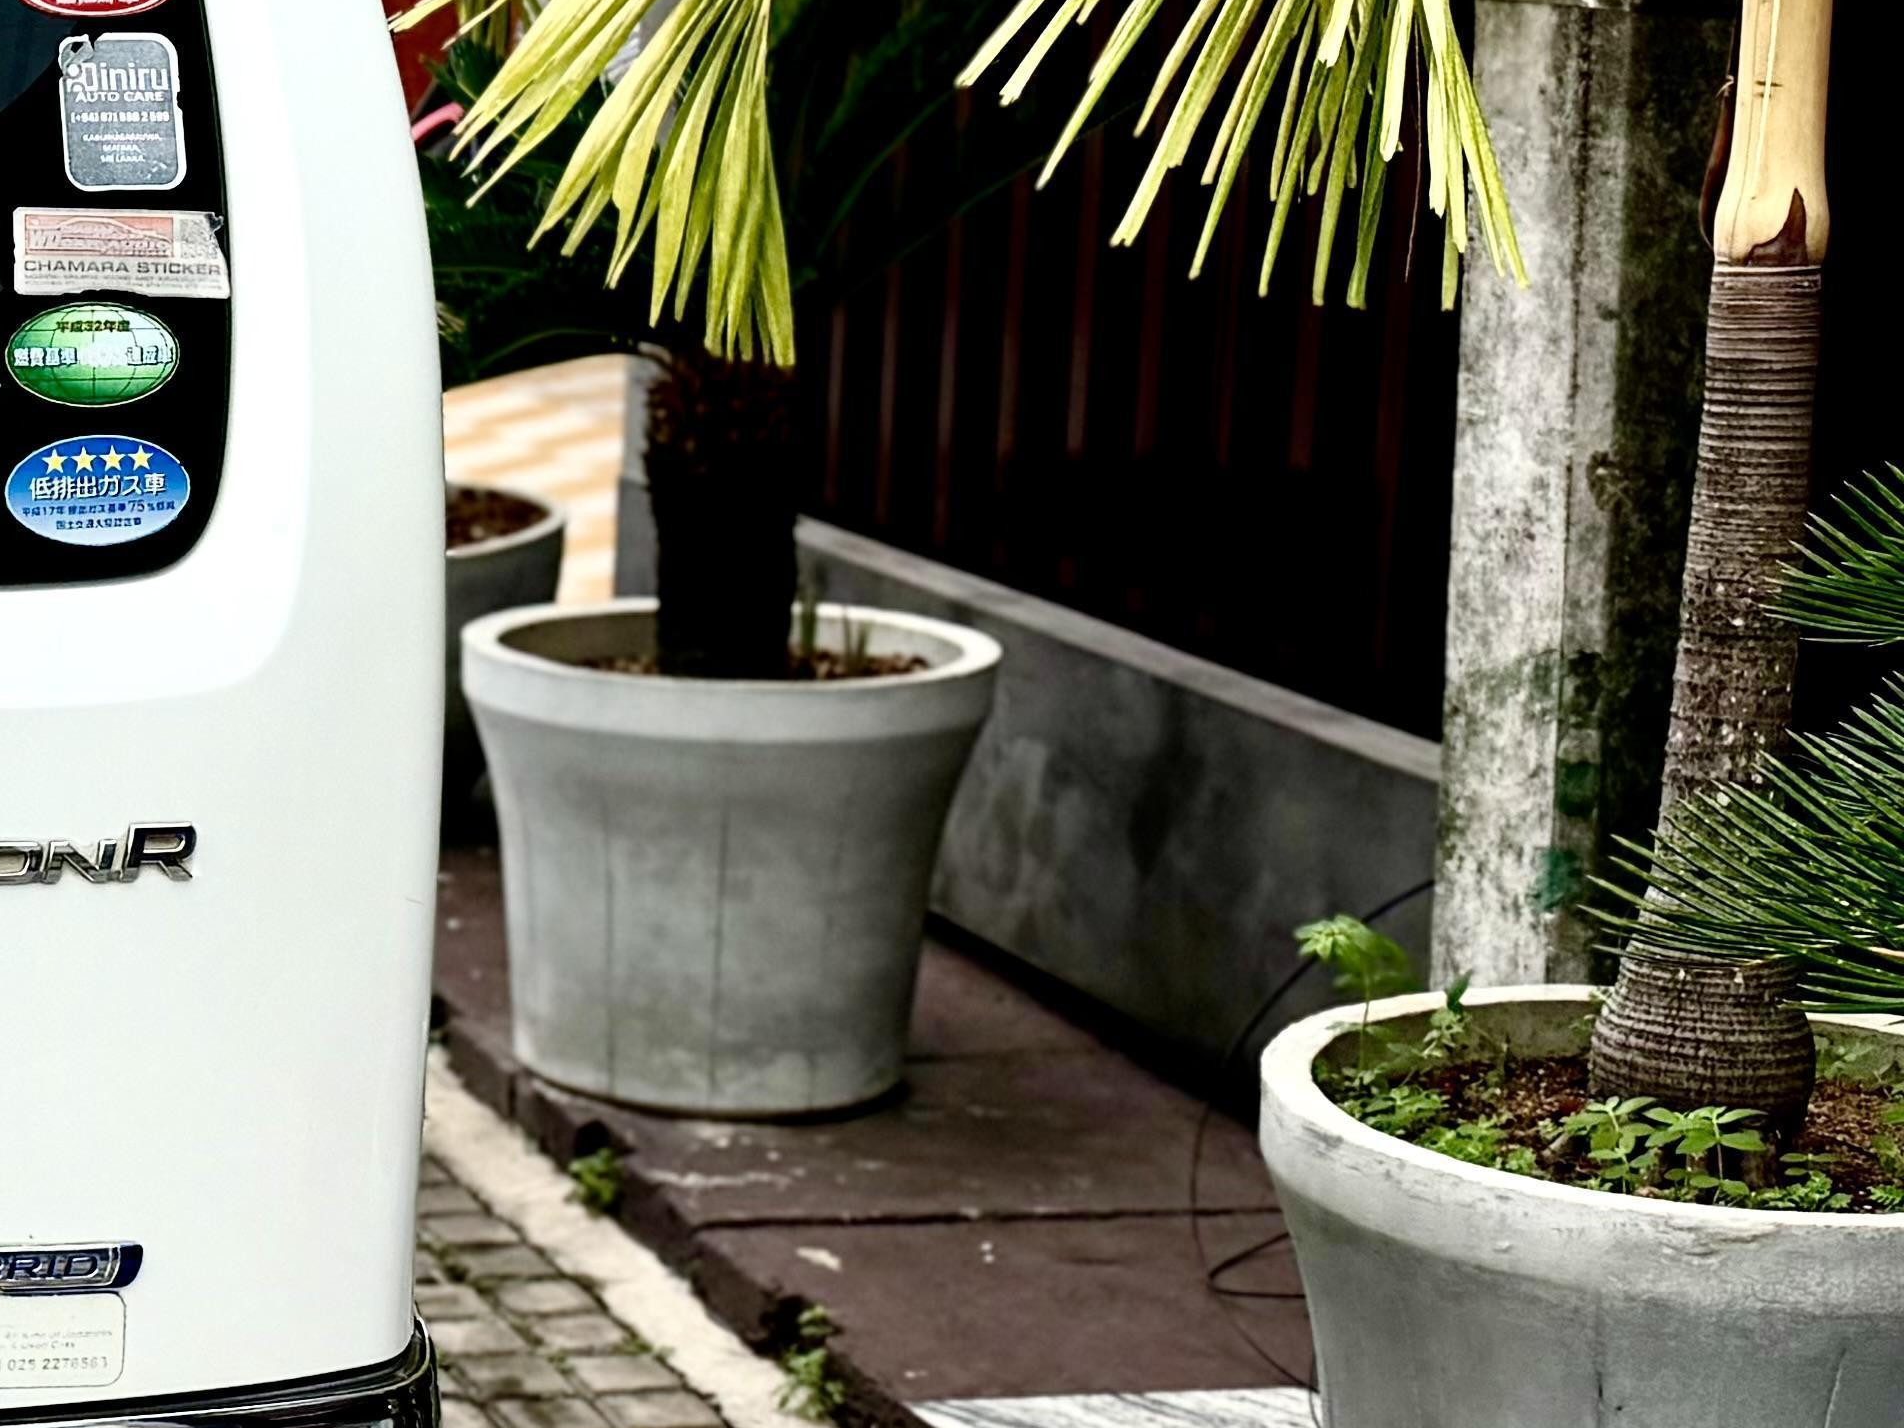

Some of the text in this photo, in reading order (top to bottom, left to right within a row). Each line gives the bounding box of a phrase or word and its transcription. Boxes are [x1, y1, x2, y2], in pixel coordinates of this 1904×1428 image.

[75, 91, 165, 103] AUTO CARE
[24, 260, 222, 275] CHAMARA STICKER
[29, 473, 166, 501] 低排出ガス車
